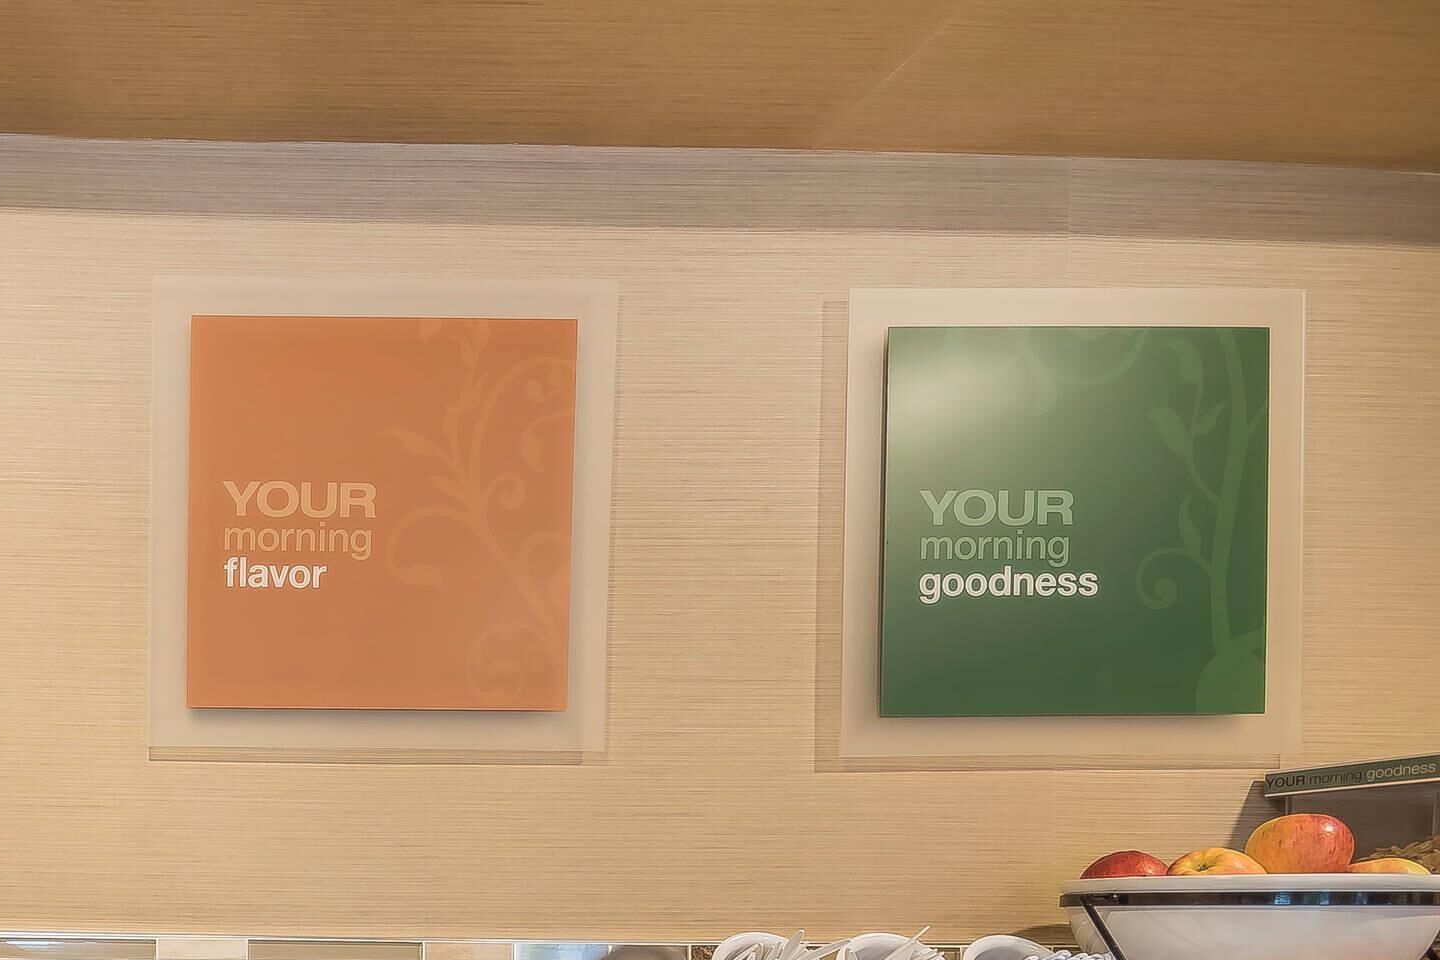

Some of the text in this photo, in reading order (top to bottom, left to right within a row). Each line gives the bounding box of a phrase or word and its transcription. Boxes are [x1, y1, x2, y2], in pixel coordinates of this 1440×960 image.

[222, 481, 377, 518] YOUR
[919, 489, 1074, 526] YOUR
[224, 521, 372, 561] morning
[920, 529, 1070, 567] morning
[223, 556, 327, 589] flavor
[919, 565, 1099, 604] goodness
[1265, 762, 1436, 789] YOUR morning goodness
